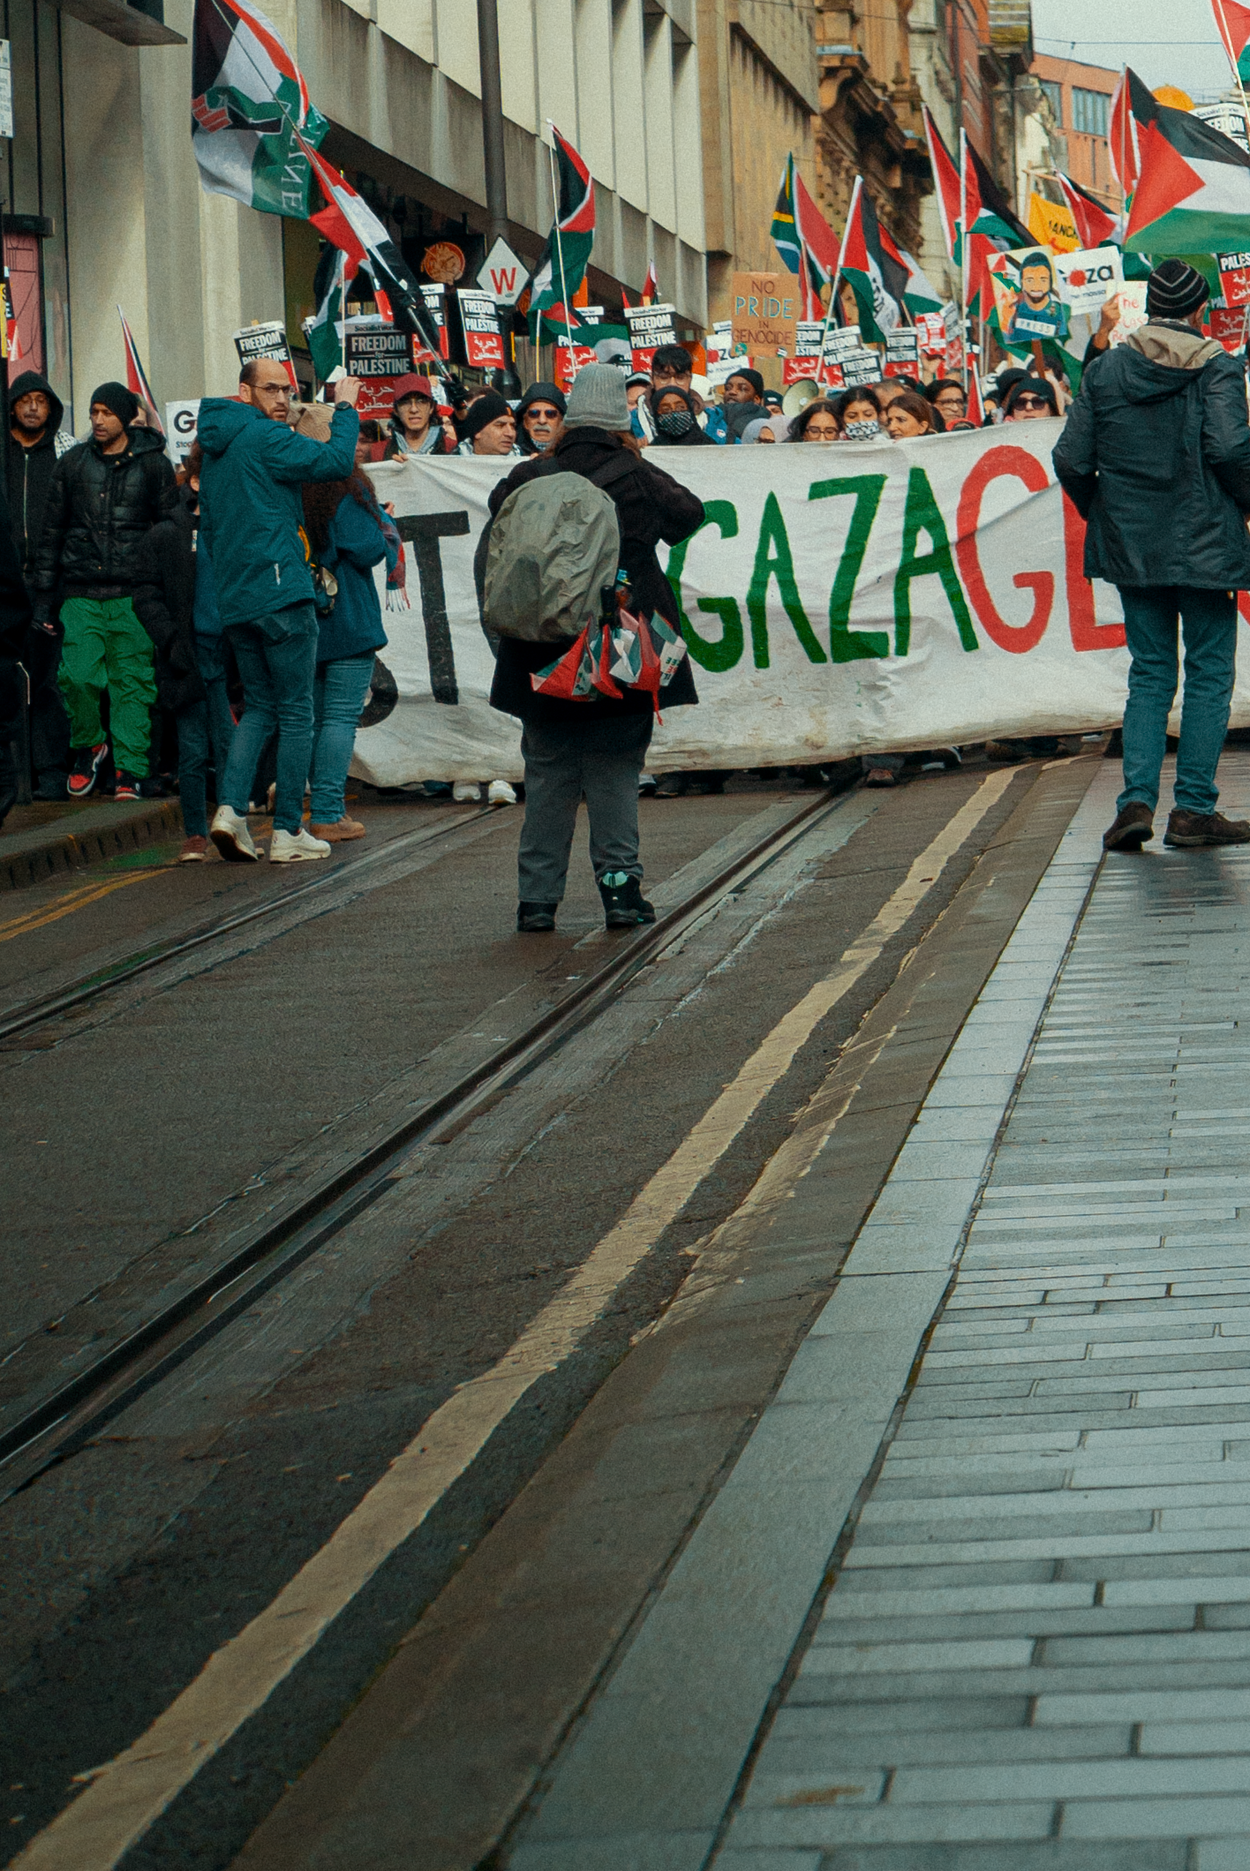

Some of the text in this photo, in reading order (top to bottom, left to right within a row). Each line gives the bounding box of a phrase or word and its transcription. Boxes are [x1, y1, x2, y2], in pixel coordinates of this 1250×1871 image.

[490, 267, 517, 296] W
[751, 280, 775, 294] NO
[735, 296, 794, 319] PRIDE
[630, 314, 672, 331] FREEDOM
[759, 320, 769, 329] IN
[1019, 320, 1052, 334] PRESS
[239, 331, 281, 351] FREEDOM
[351, 335, 406, 352] FREEDOM
[631, 331, 676, 348] PALESTINE
[732, 329, 793, 346] GENOCIDE
[349, 358, 411, 376] PALESTINE
[666, 467, 979, 674] GAZA
